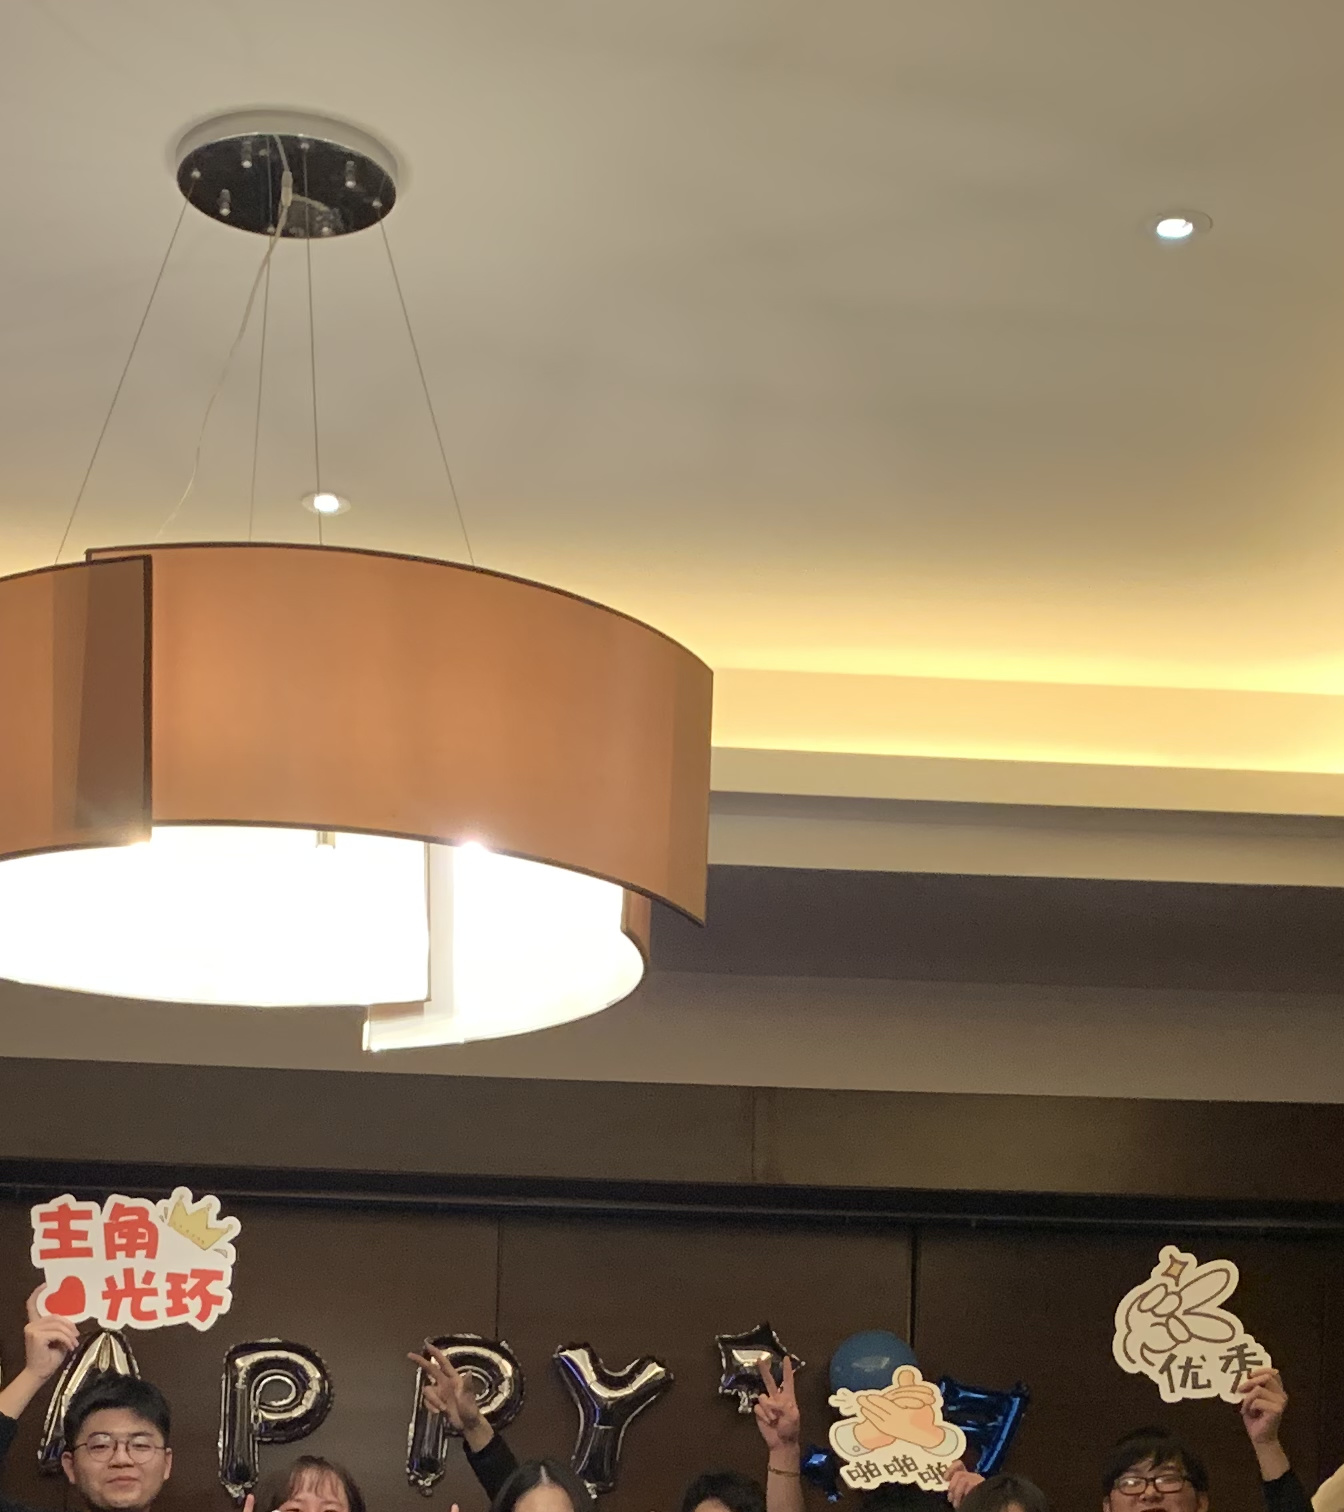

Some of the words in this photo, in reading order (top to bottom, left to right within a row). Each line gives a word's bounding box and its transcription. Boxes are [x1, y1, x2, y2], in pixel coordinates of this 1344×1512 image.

[39, 1203, 159, 1260] 主角
[101, 1268, 224, 1324] 光环
[1159, 1342, 1263, 1394] 优秀
